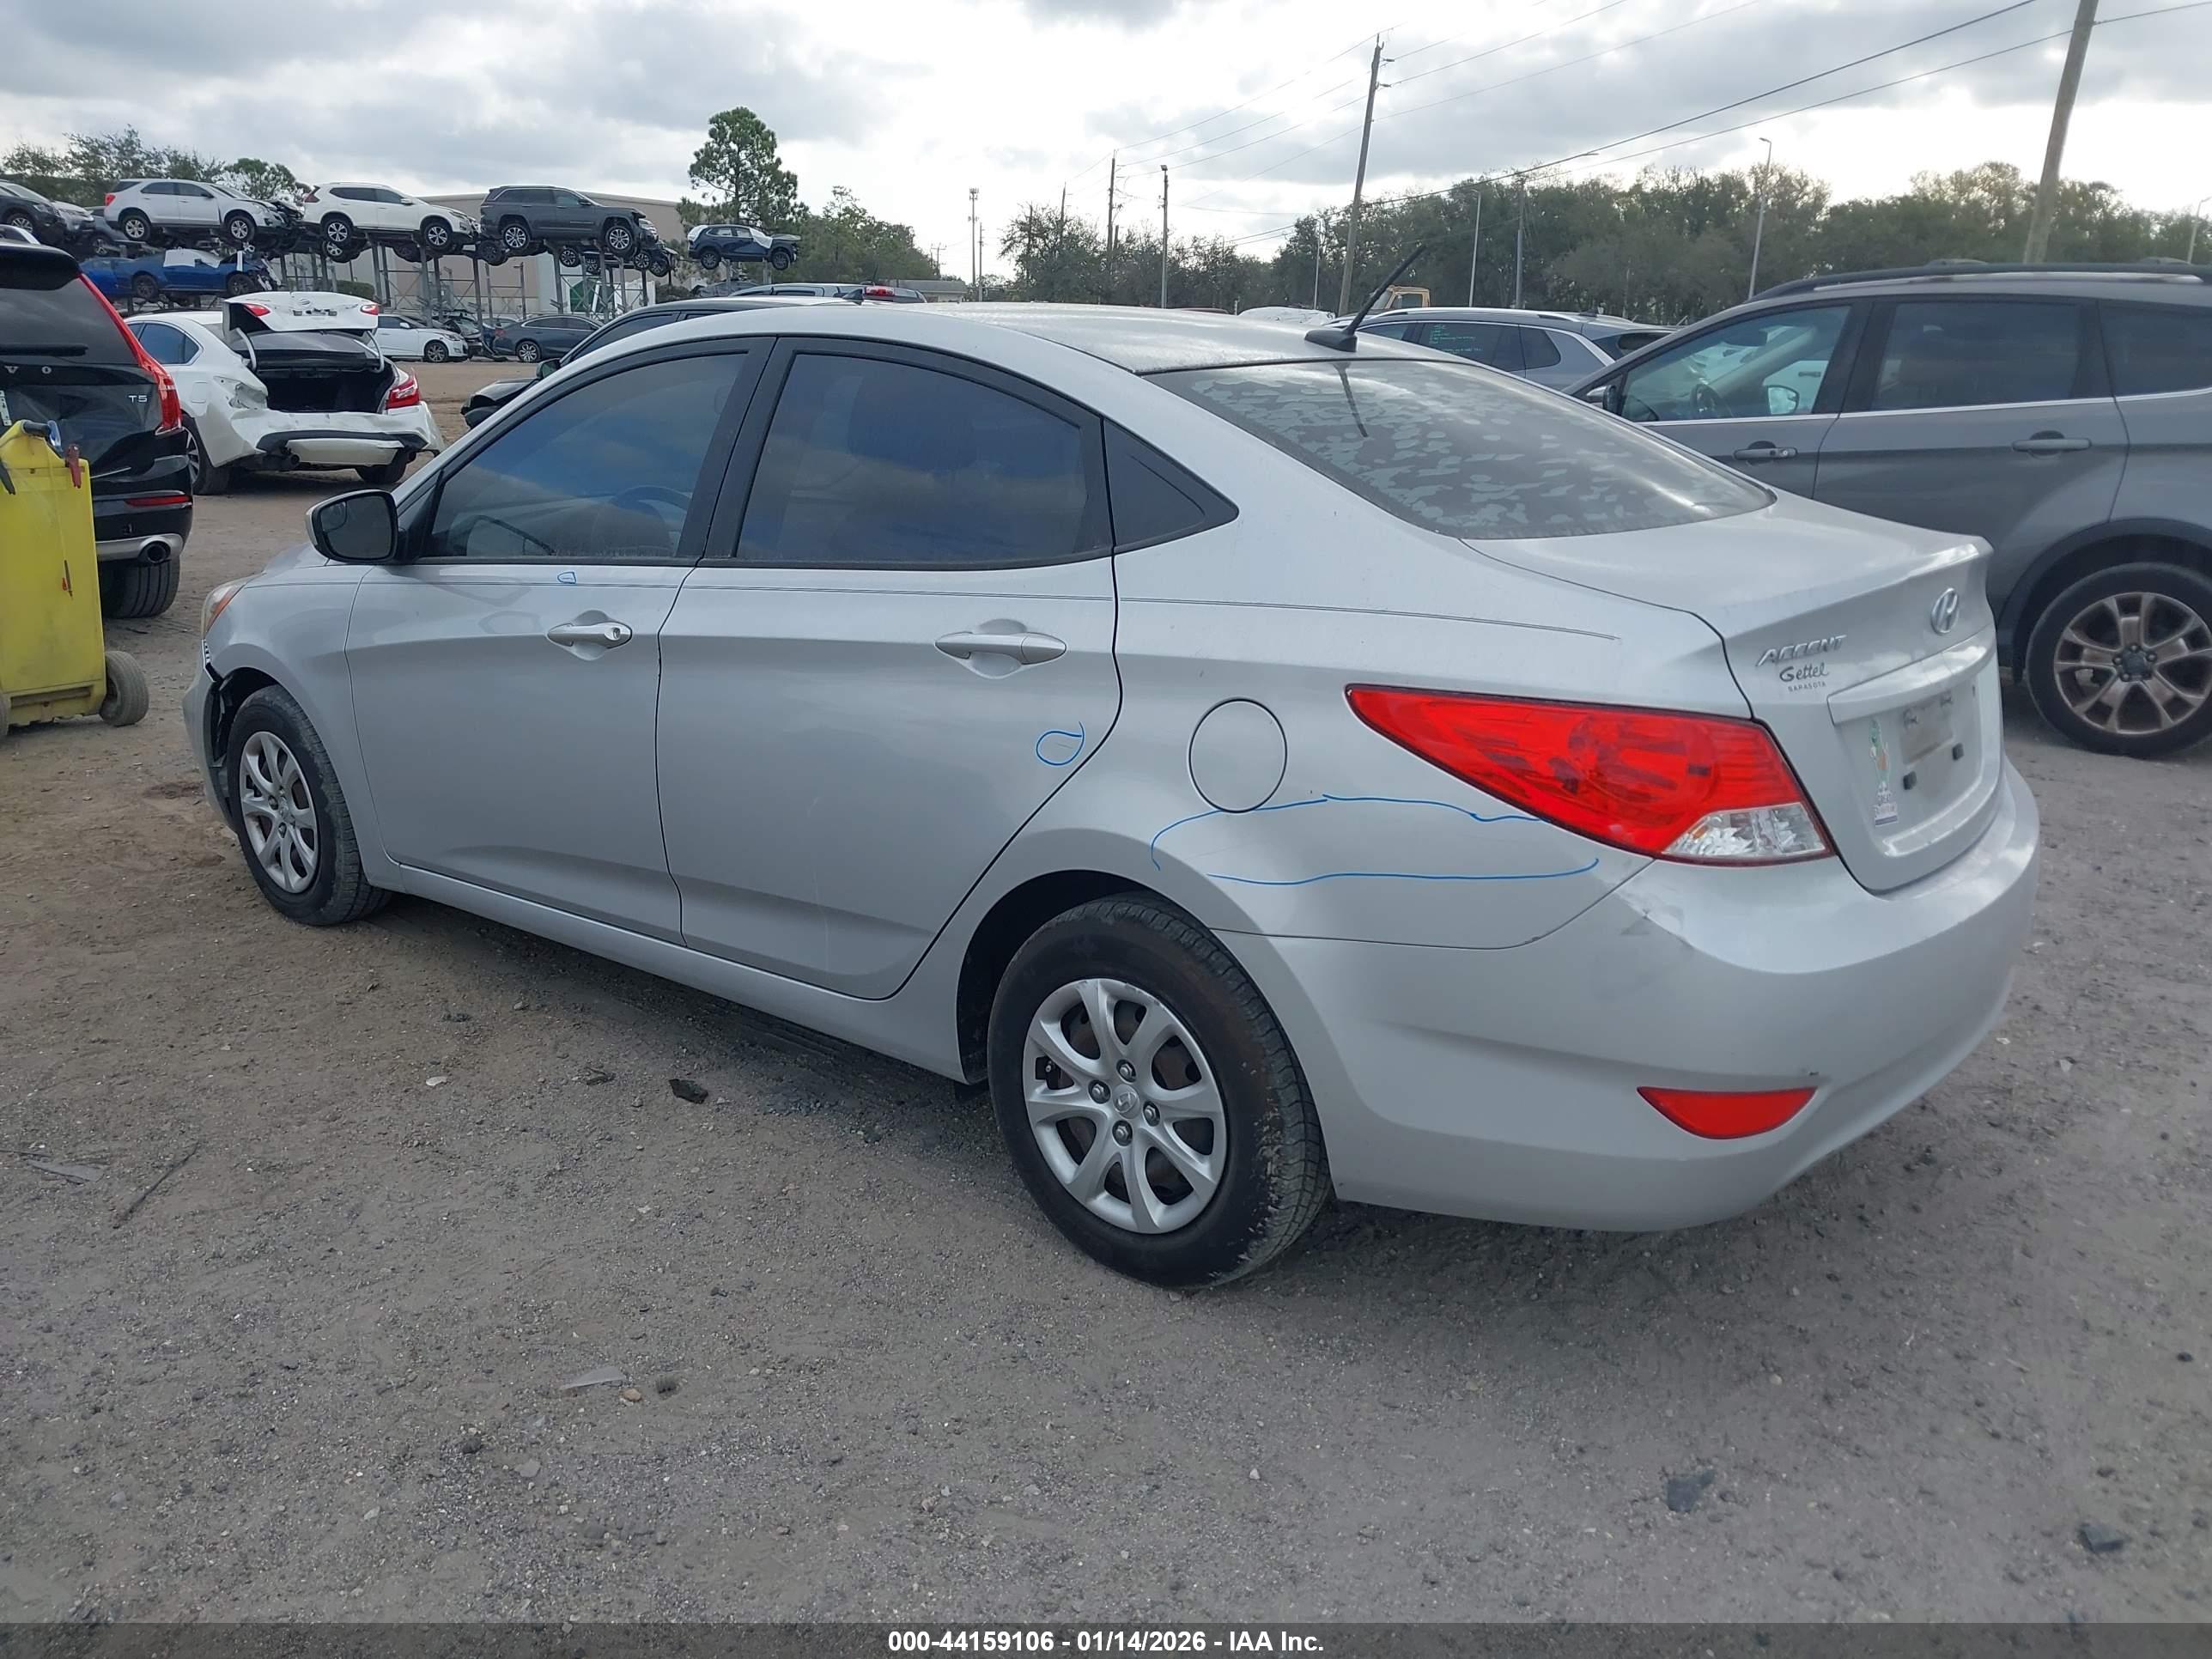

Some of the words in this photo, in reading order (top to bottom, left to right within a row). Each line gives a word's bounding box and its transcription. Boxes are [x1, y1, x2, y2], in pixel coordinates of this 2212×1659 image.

[128, 395, 148, 404] T5
[1755, 635, 1847, 667] ACCENT
[1779, 662, 1829, 683] Gettel
